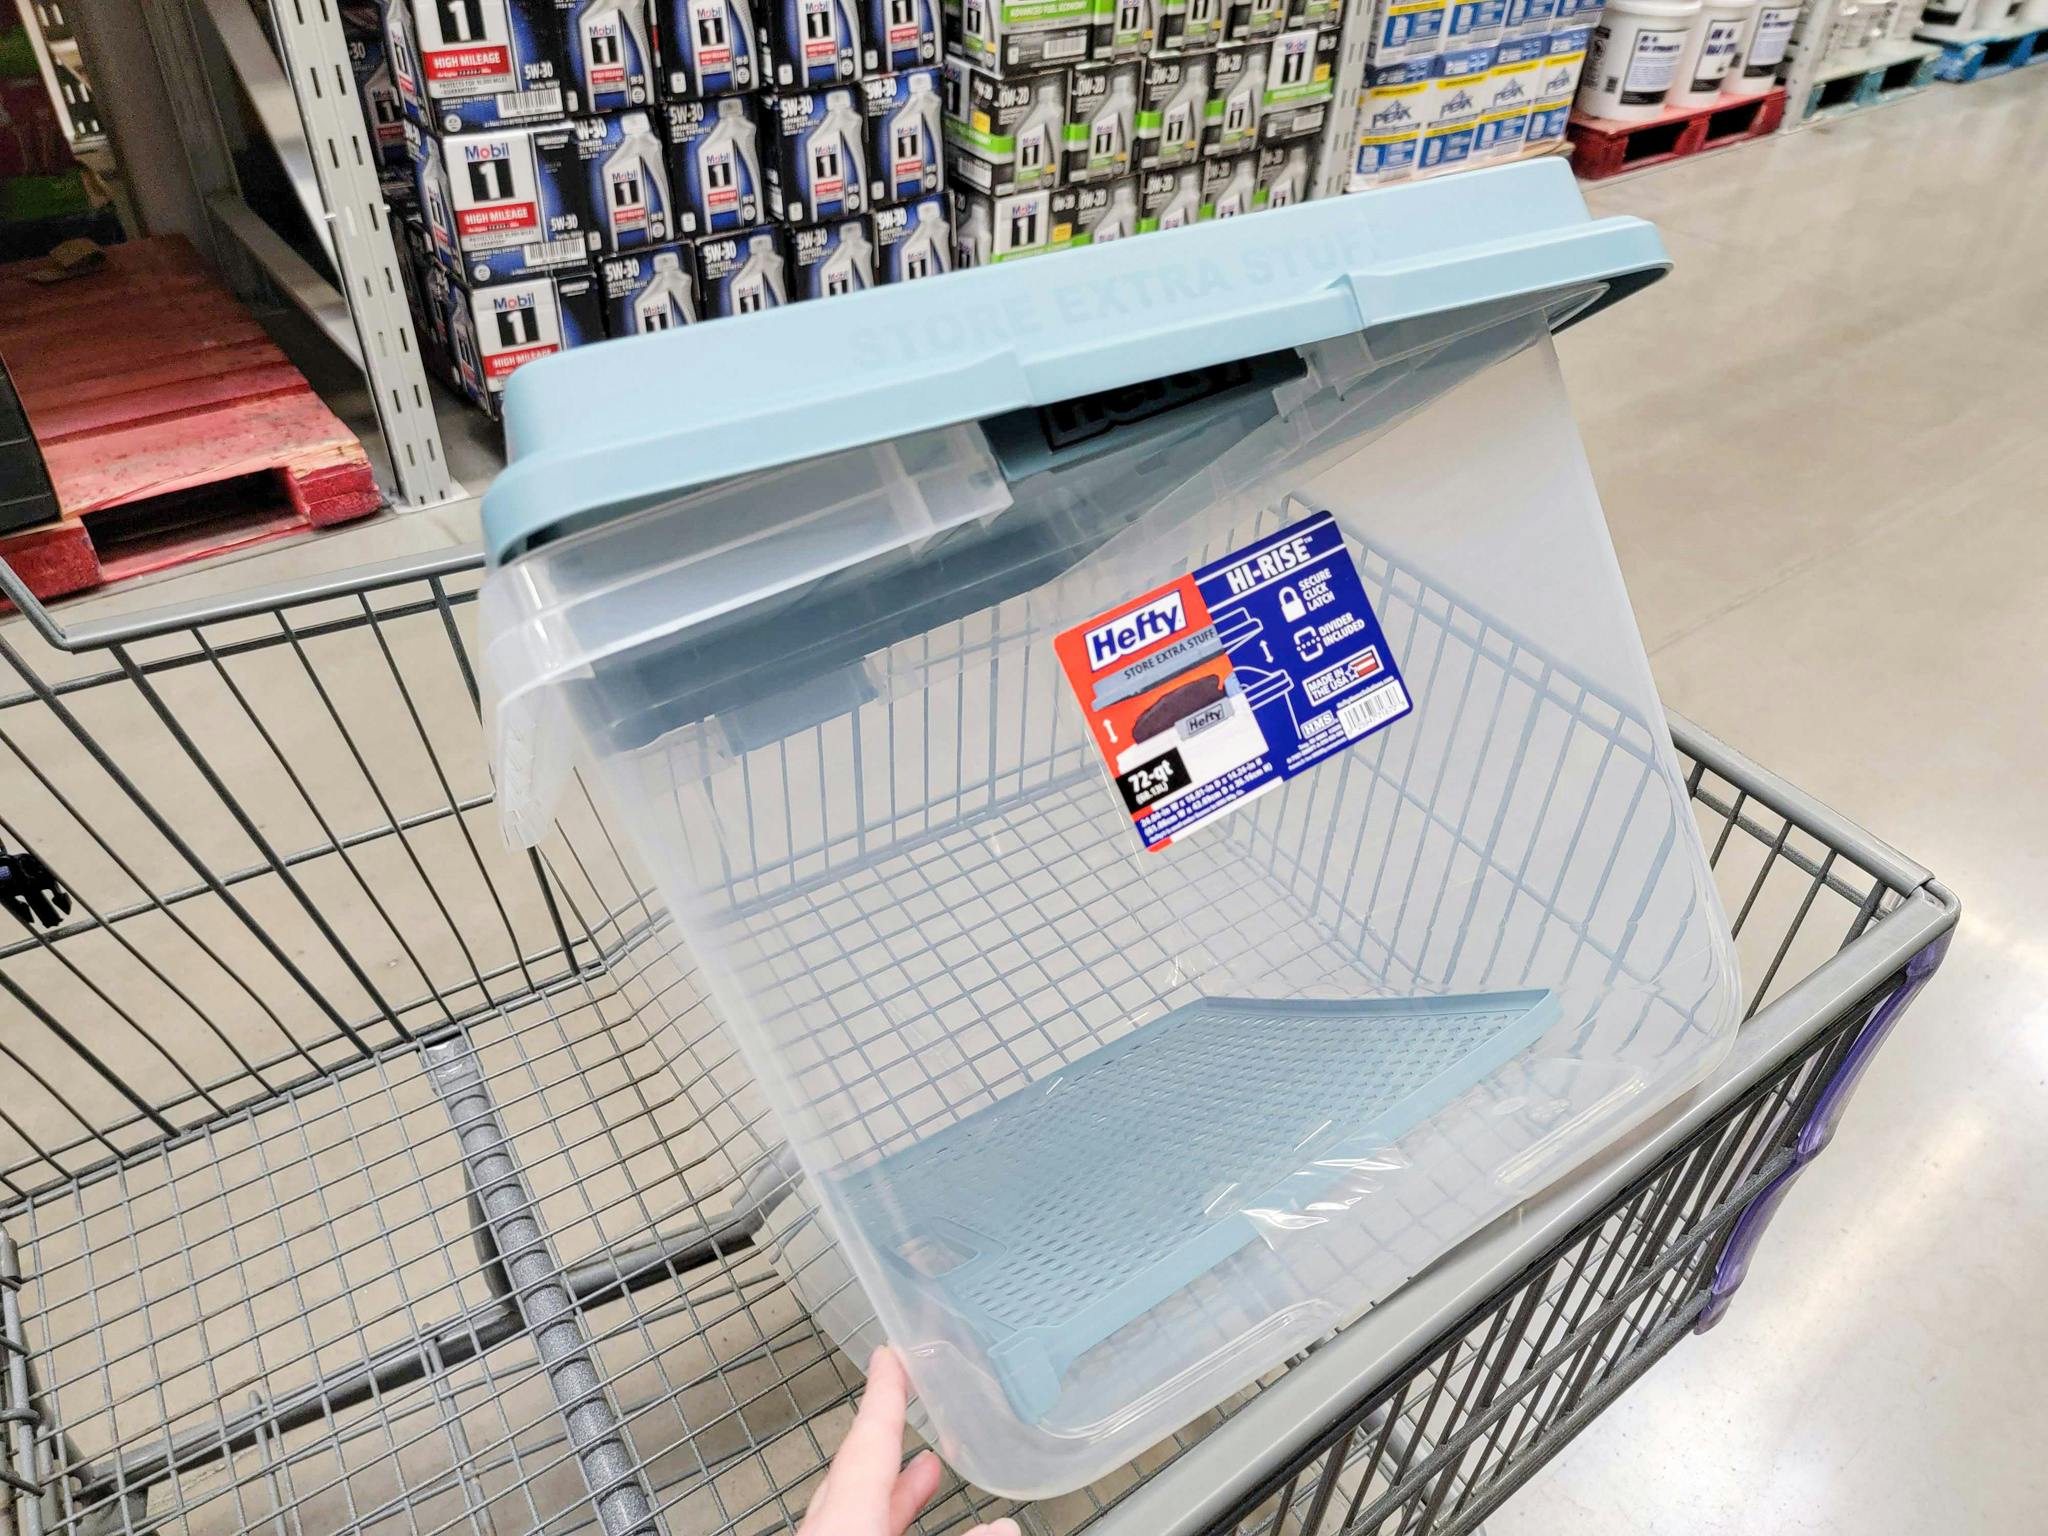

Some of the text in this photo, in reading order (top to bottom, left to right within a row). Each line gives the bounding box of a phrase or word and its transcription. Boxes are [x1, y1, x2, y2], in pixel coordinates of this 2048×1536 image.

[697, 7, 723, 18] Mobil
[589, 24, 616, 37] Mobil
[704, 19, 718, 45] 1
[812, 12, 824, 38] 1
[434, 50, 501, 70] HIGH MILEAGE
[597, 36, 611, 64] 1
[524, 60, 554, 80] 5W-30
[1288, 54, 1299, 82] 1
[867, 78, 898, 100] 5W-30
[670, 102, 704, 125] 5W-30
[781, 95, 813, 119] 5W-30
[576, 117, 608, 140] W-30
[465, 143, 510, 161] Mobil
[707, 152, 731, 164] Mobil
[902, 136, 913, 157] 1
[612, 169, 639, 182] Mobil
[712, 164, 725, 187] 1
[820, 155, 832, 177] 1
[478, 161, 501, 200] 1
[619, 182, 632, 205] 1
[464, 207, 528, 226] HIGH MILEAGE
[877, 207, 908, 230] 5W-30
[1012, 201, 1038, 218] Mobil
[550, 214, 578, 232] 5W-30
[1017, 216, 1030, 246] 1
[796, 228, 828, 250] 5W-30
[703, 240, 737, 263] 5W-30
[604, 258, 640, 282] 5W-30
[493, 292, 535, 311] Mobil
[848, 294, 1043, 371] STORE
[1056, 259, 1232, 326] EXTRA
[507, 310, 527, 345] 1
[493, 356, 516, 369] HIGH
[1298, 568, 1333, 590] SECURE
[1302, 582, 1330, 602] CLICK
[1307, 592, 1337, 612] LATCH
[1092, 605, 1179, 662] Hefty
[1318, 612, 1355, 637] DIVIDER
[1322, 619, 1366, 647] INCLUDED
[1124, 629, 1216, 680] STORE EXTRA STUFF
[1307, 667, 1346, 691] MADE IN
[1312, 685, 1332, 701] THE
[1331, 676, 1349, 693] USA
[1189, 705, 1222, 731] Hefty
[1303, 712, 1335, 737] HMS
[1128, 759, 1174, 793] 72-qt
